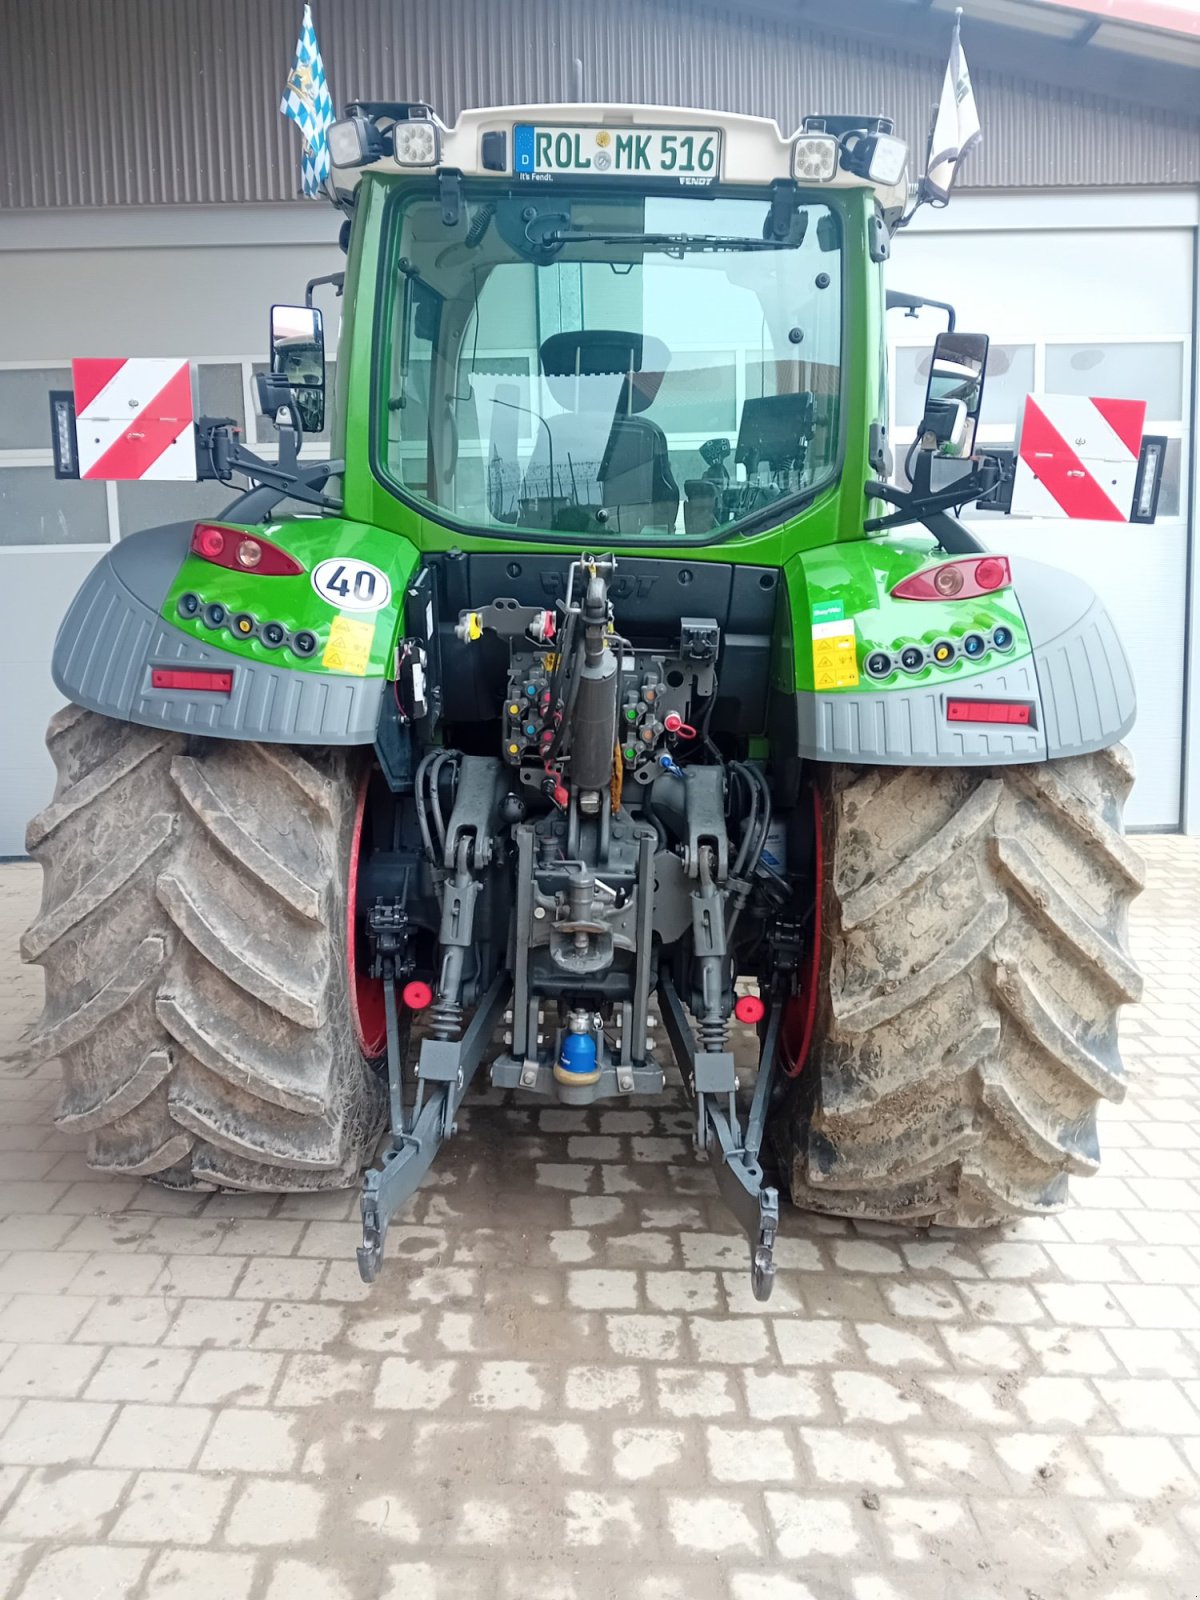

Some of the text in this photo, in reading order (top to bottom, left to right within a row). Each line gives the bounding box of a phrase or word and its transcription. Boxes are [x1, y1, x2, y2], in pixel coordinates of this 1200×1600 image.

[521, 154, 530, 165] D
[535, 131, 714, 171] ROL MK 516
[679, 177, 713, 186] FENDT
[326, 565, 376, 601] 40
[540, 571, 660, 599] FEDT
